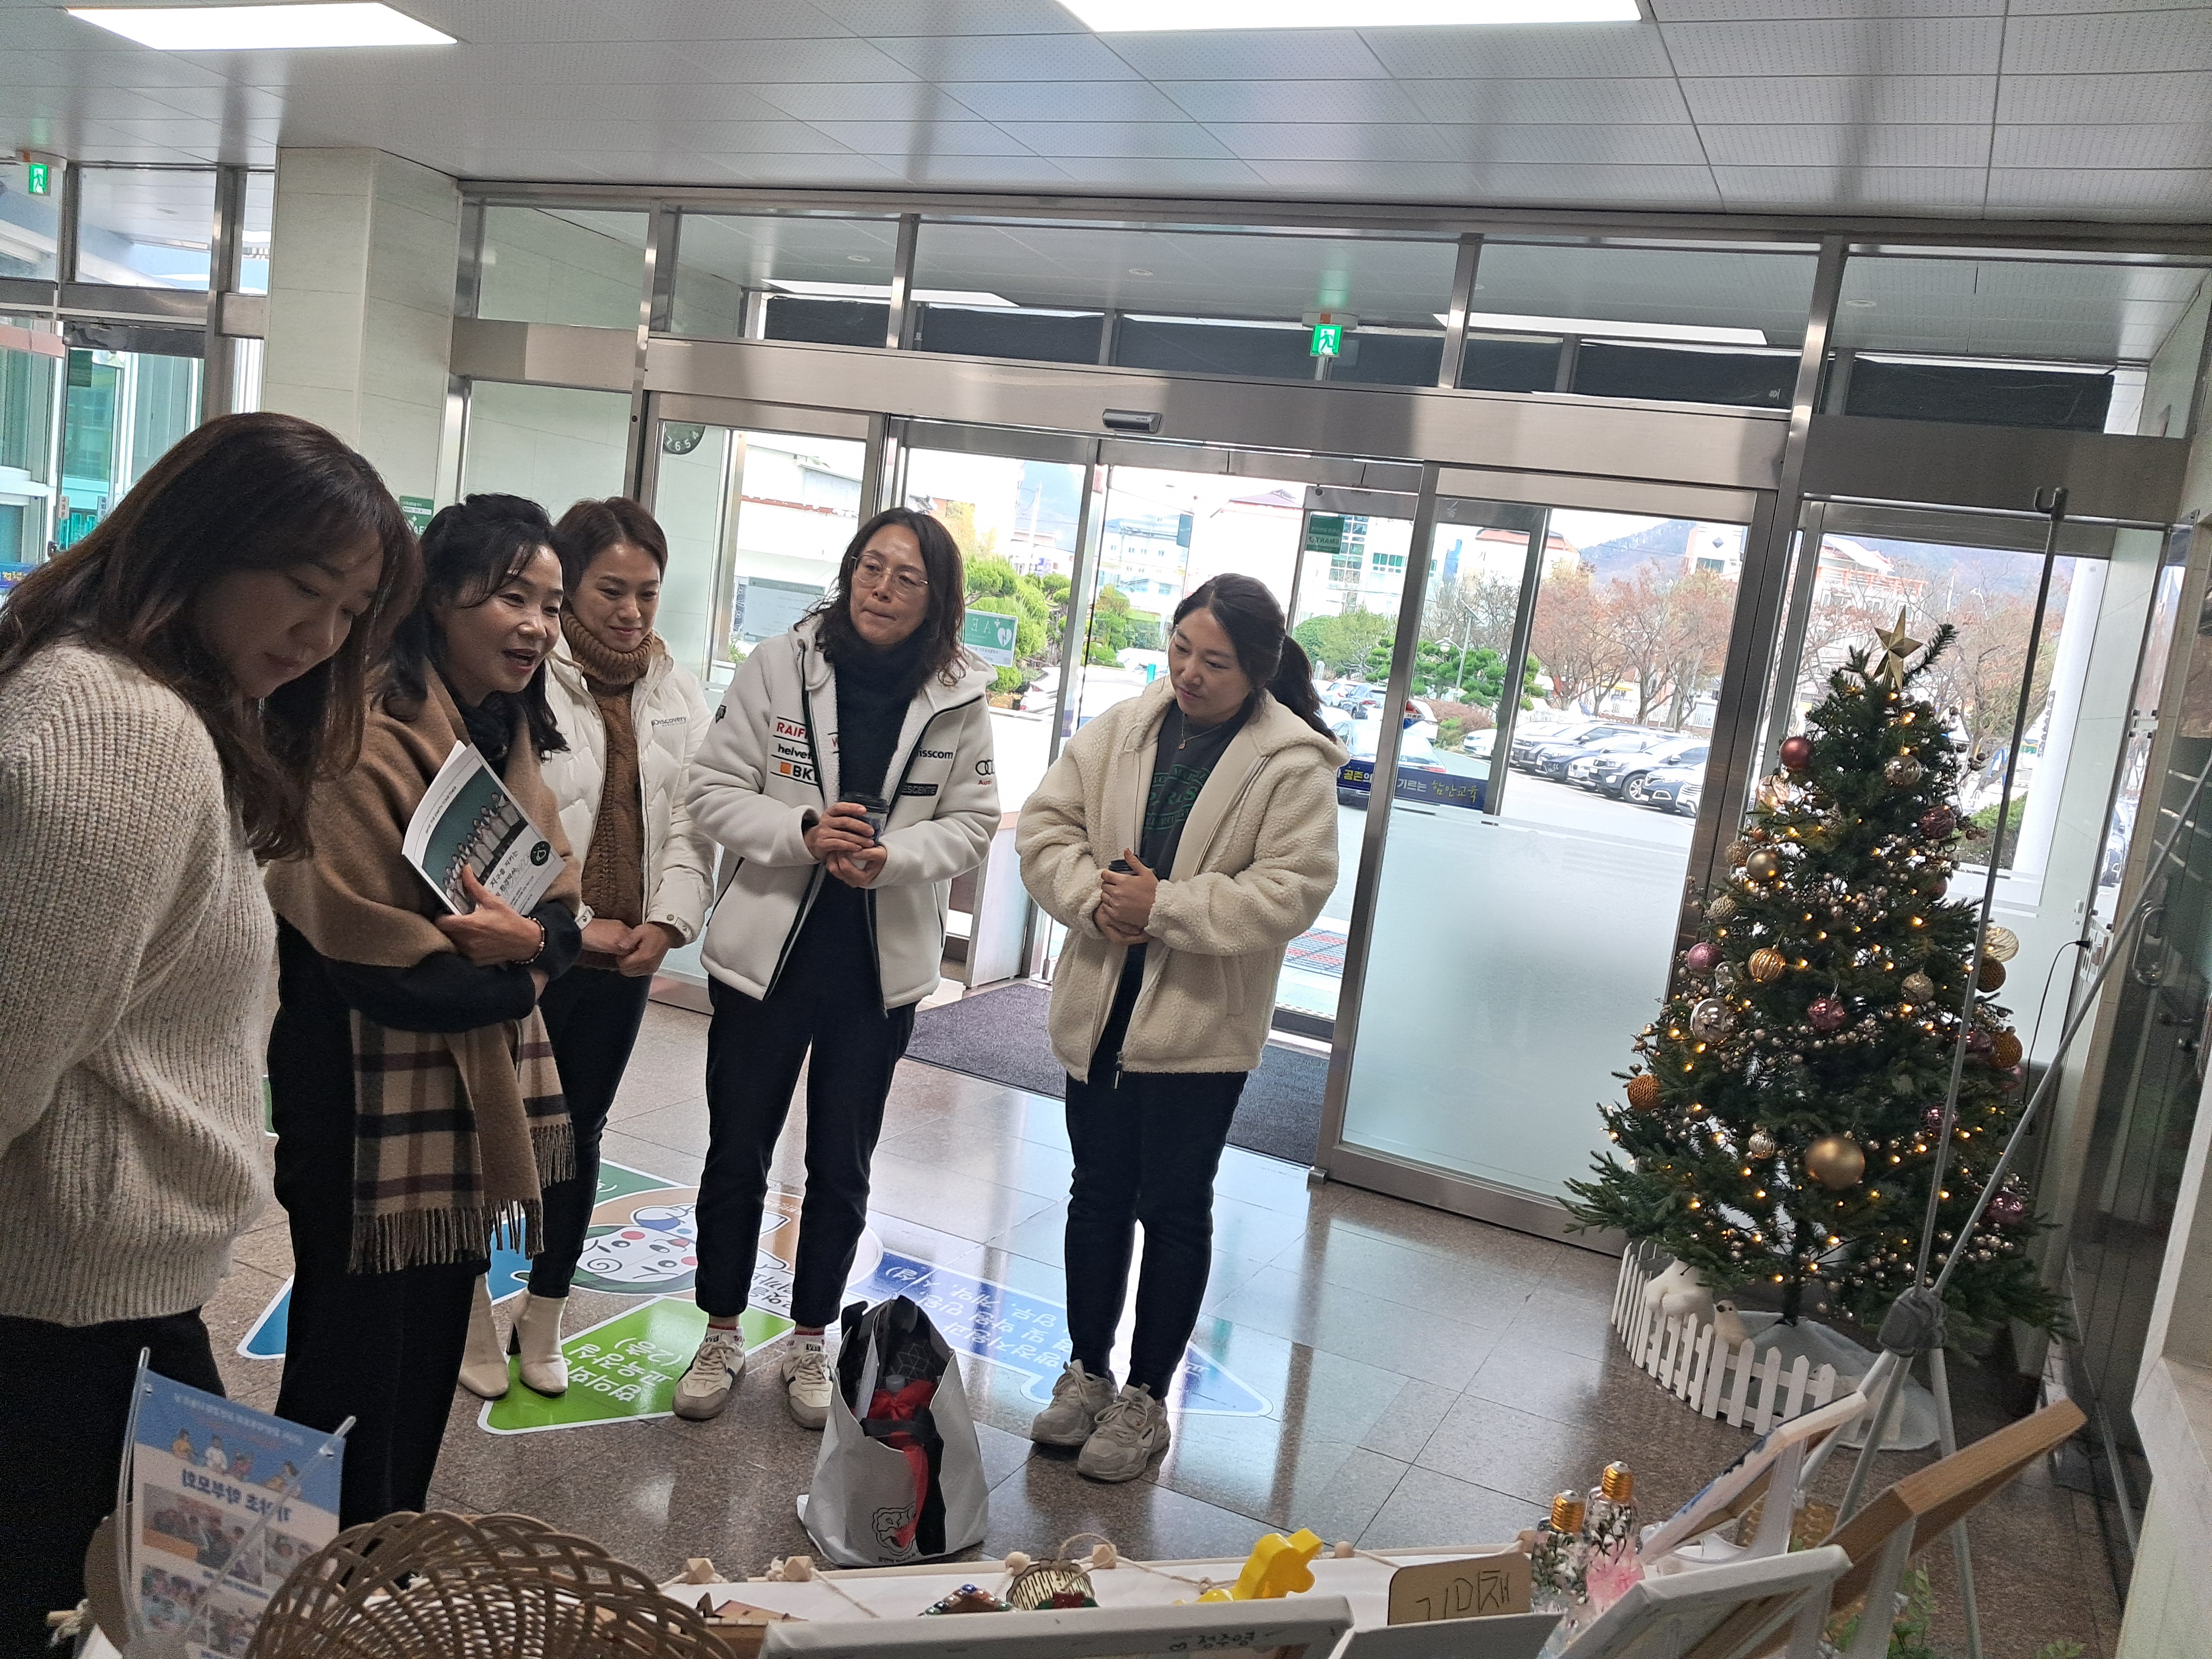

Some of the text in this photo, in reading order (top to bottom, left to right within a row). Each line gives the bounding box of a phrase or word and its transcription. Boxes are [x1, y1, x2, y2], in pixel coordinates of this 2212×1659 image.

[666, 436, 673, 445] 7
[684, 438, 691, 449] 5
[692, 430, 699, 440] 4
[675, 441, 681, 451] 6
[414, 525, 426, 535] AE
[1343, 769, 1373, 784] 공존의
[1397, 778, 1427, 793] 기르는
[1431, 780, 1480, 803] 함안교육
[490, 869, 506, 888] 지구를
[504, 850, 520, 866] 지키는
[969, 1310, 1017, 1334] 학원
[1023, 1326, 1046, 1342] 및
[614, 1336, 683, 1367] (2층)
[942, 1321, 1060, 1370] 행정지원과
[567, 1343, 674, 1387] 교육장실
